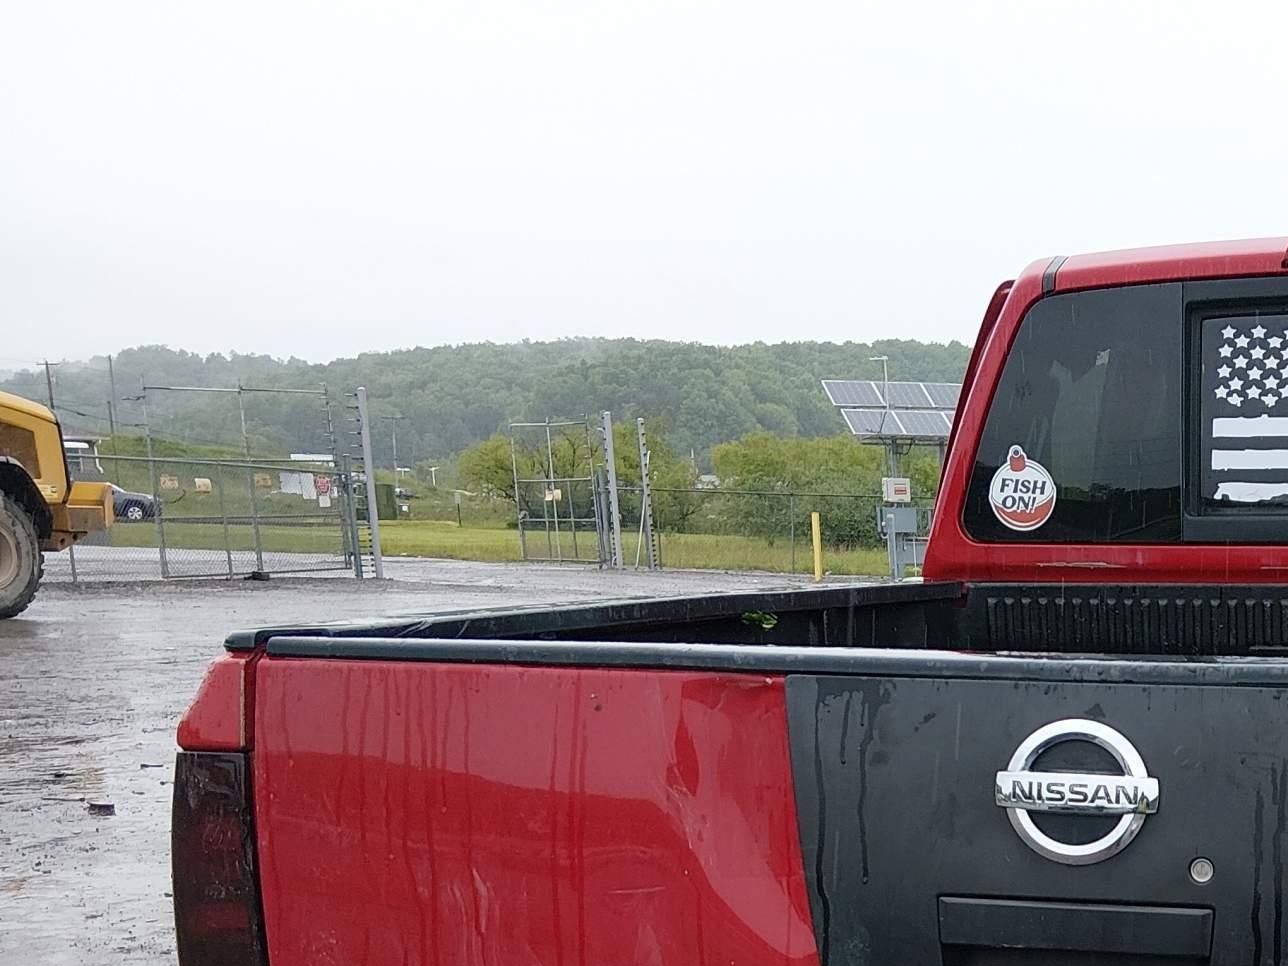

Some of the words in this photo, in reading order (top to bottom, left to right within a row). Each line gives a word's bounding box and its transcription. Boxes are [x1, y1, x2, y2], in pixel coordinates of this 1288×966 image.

[1000, 478, 1047, 495] FISH
[1001, 495, 1037, 511] ON!
[1011, 780, 1139, 805] NISSAN
